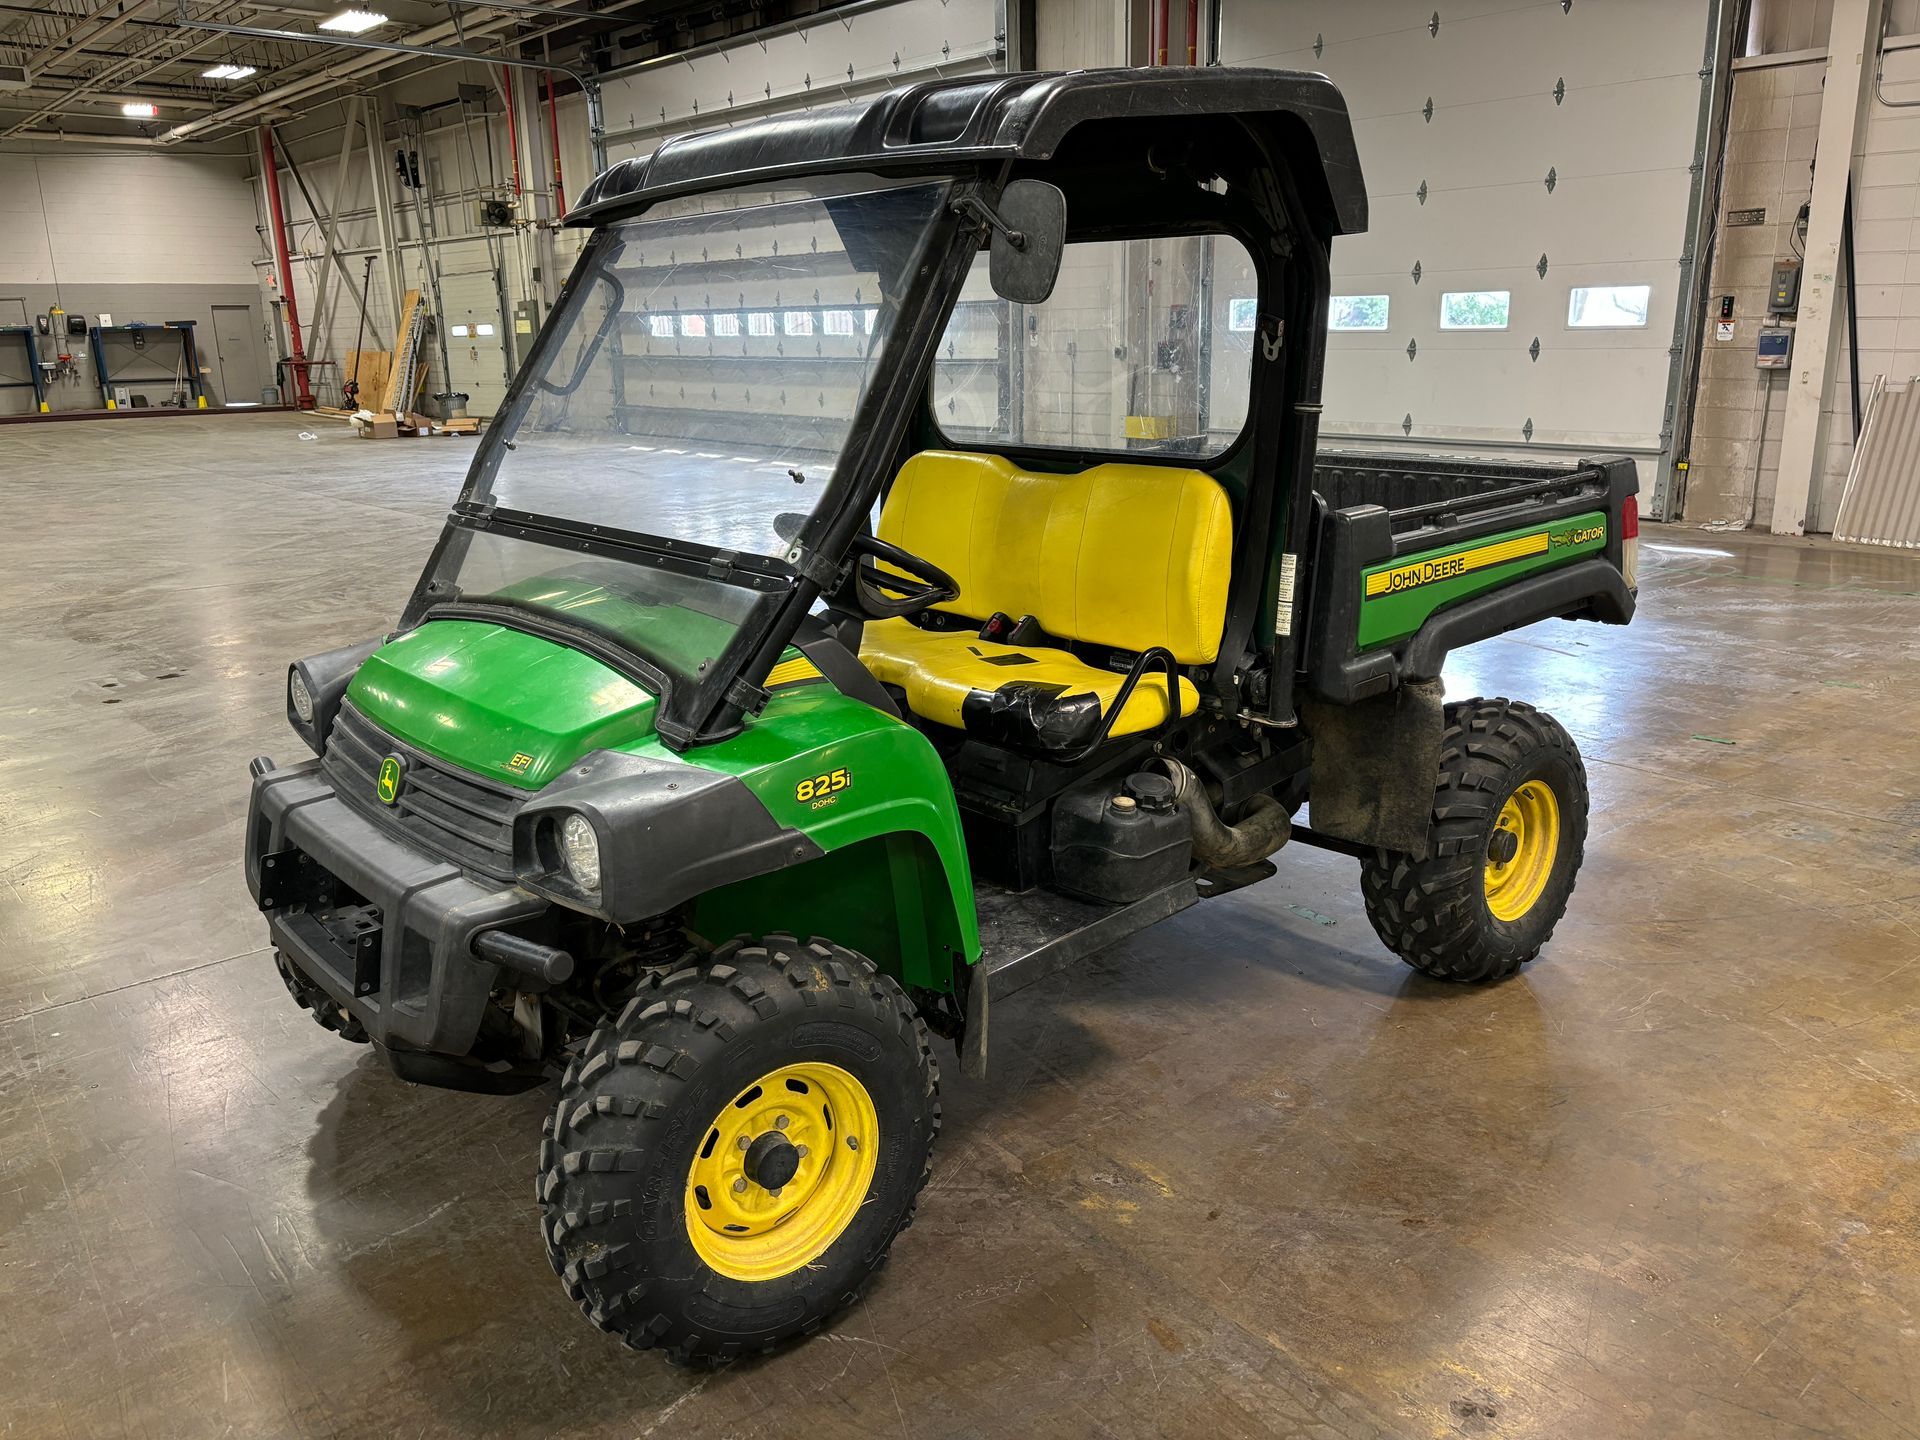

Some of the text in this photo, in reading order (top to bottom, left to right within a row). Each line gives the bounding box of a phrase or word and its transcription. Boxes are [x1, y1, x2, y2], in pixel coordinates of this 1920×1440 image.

[1574, 525, 1605, 545] GATOR
[1385, 557, 1465, 591] JOHN DEERE
[510, 753, 533, 769] EFI
[796, 768, 851, 802] 825i
[811, 796, 836, 810] DOHC
